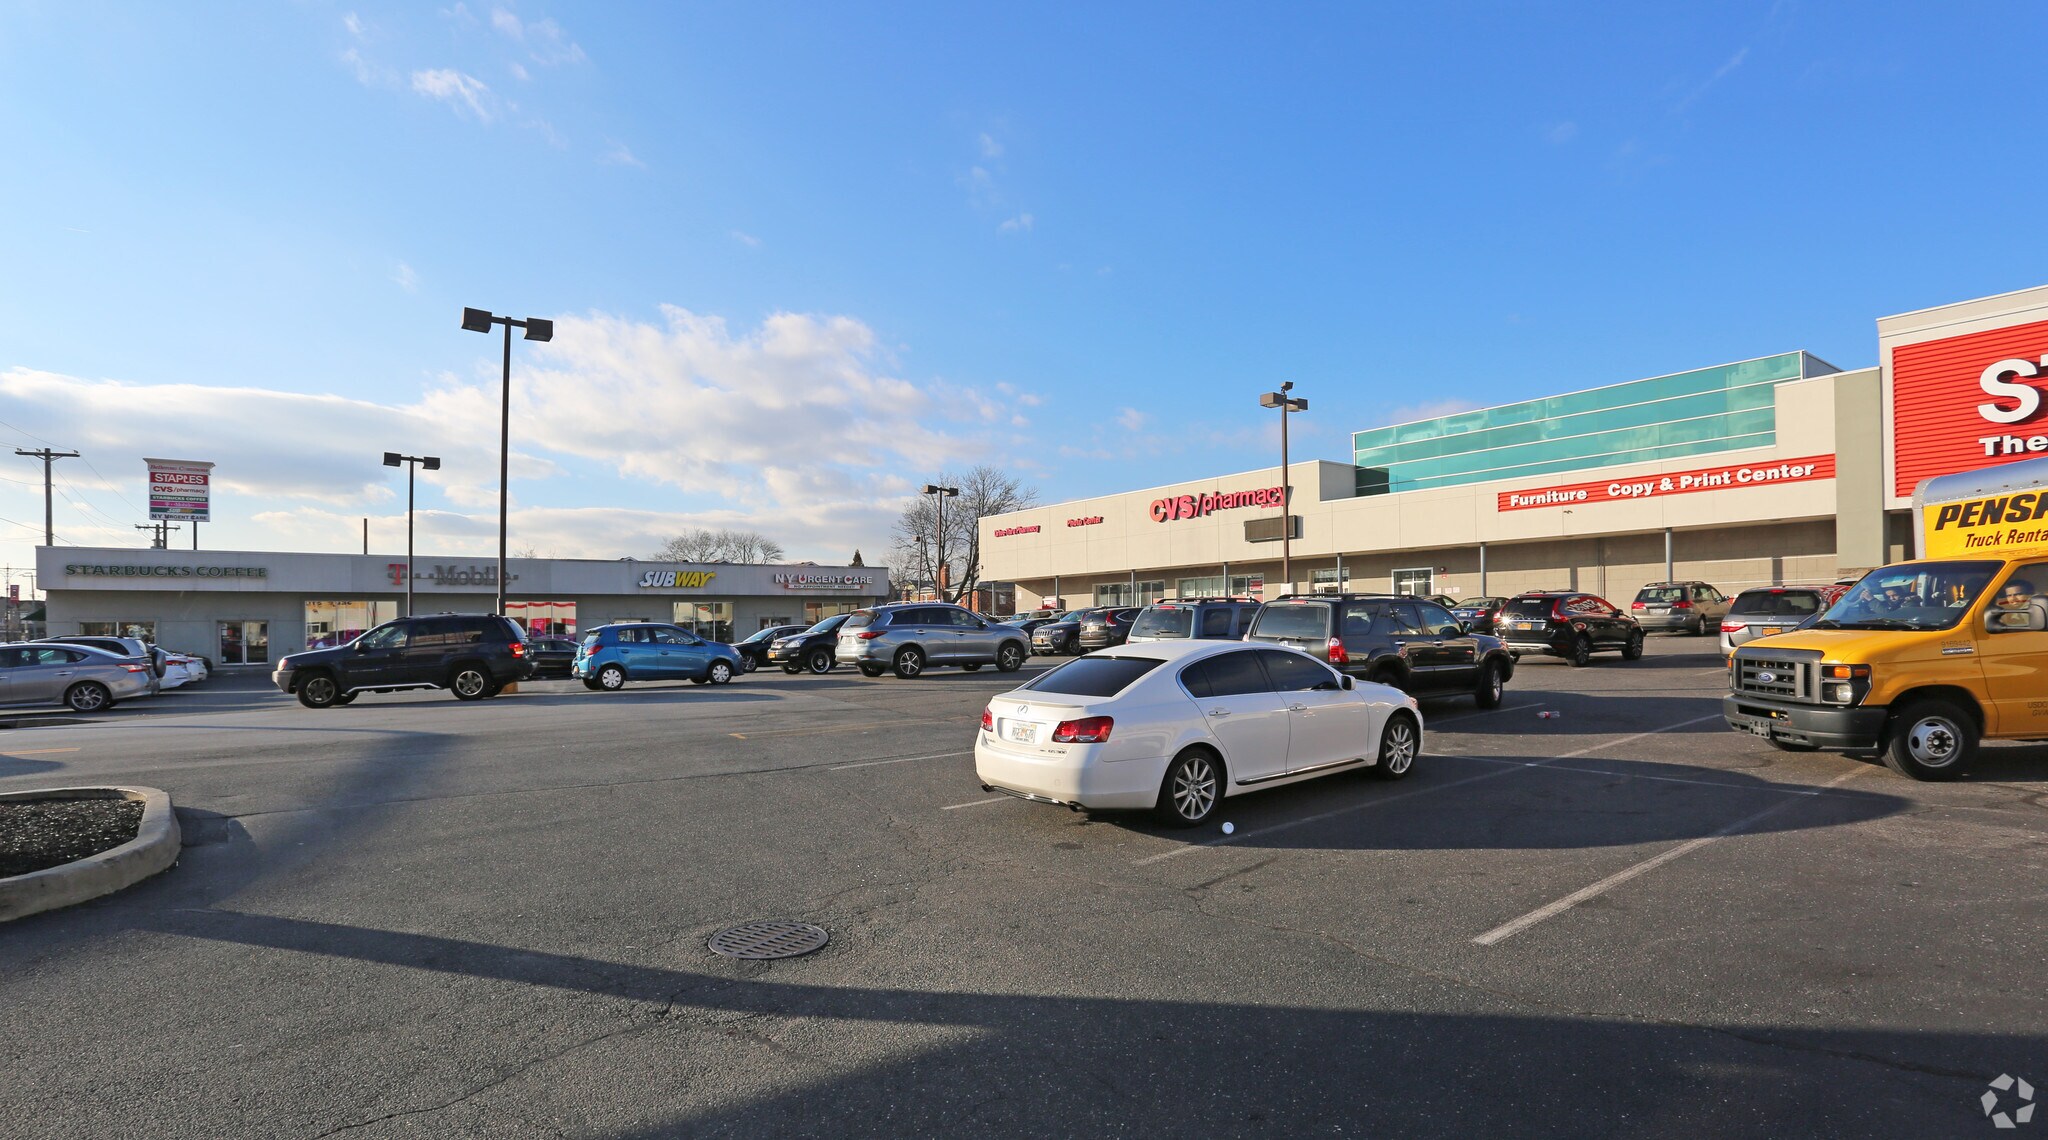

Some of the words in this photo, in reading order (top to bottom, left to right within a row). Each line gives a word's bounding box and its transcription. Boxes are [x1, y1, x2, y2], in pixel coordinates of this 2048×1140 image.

[1977, 354, 2048, 423] S
[1977, 434, 2048, 456] The
[154, 473, 204, 484] STAPLES
[1510, 488, 1588, 507] Furniture
[1607, 480, 1655, 498] Copy
[1659, 477, 1675, 491] &
[1680, 470, 1731, 489] Print
[1736, 462, 1816, 483] Center
[153, 486, 206, 494] CVS/pharmacy
[1965, 530, 2003, 548] Truck
[2006, 528, 2048, 545] Renta
[65, 564, 191, 577] STARBUCKS
[196, 566, 267, 578] COFFEE
[638, 570, 717, 588] SUBWAY
[774, 573, 795, 584] NY
[798, 574, 841, 584] URGENT
[843, 575, 873, 585] CARE
